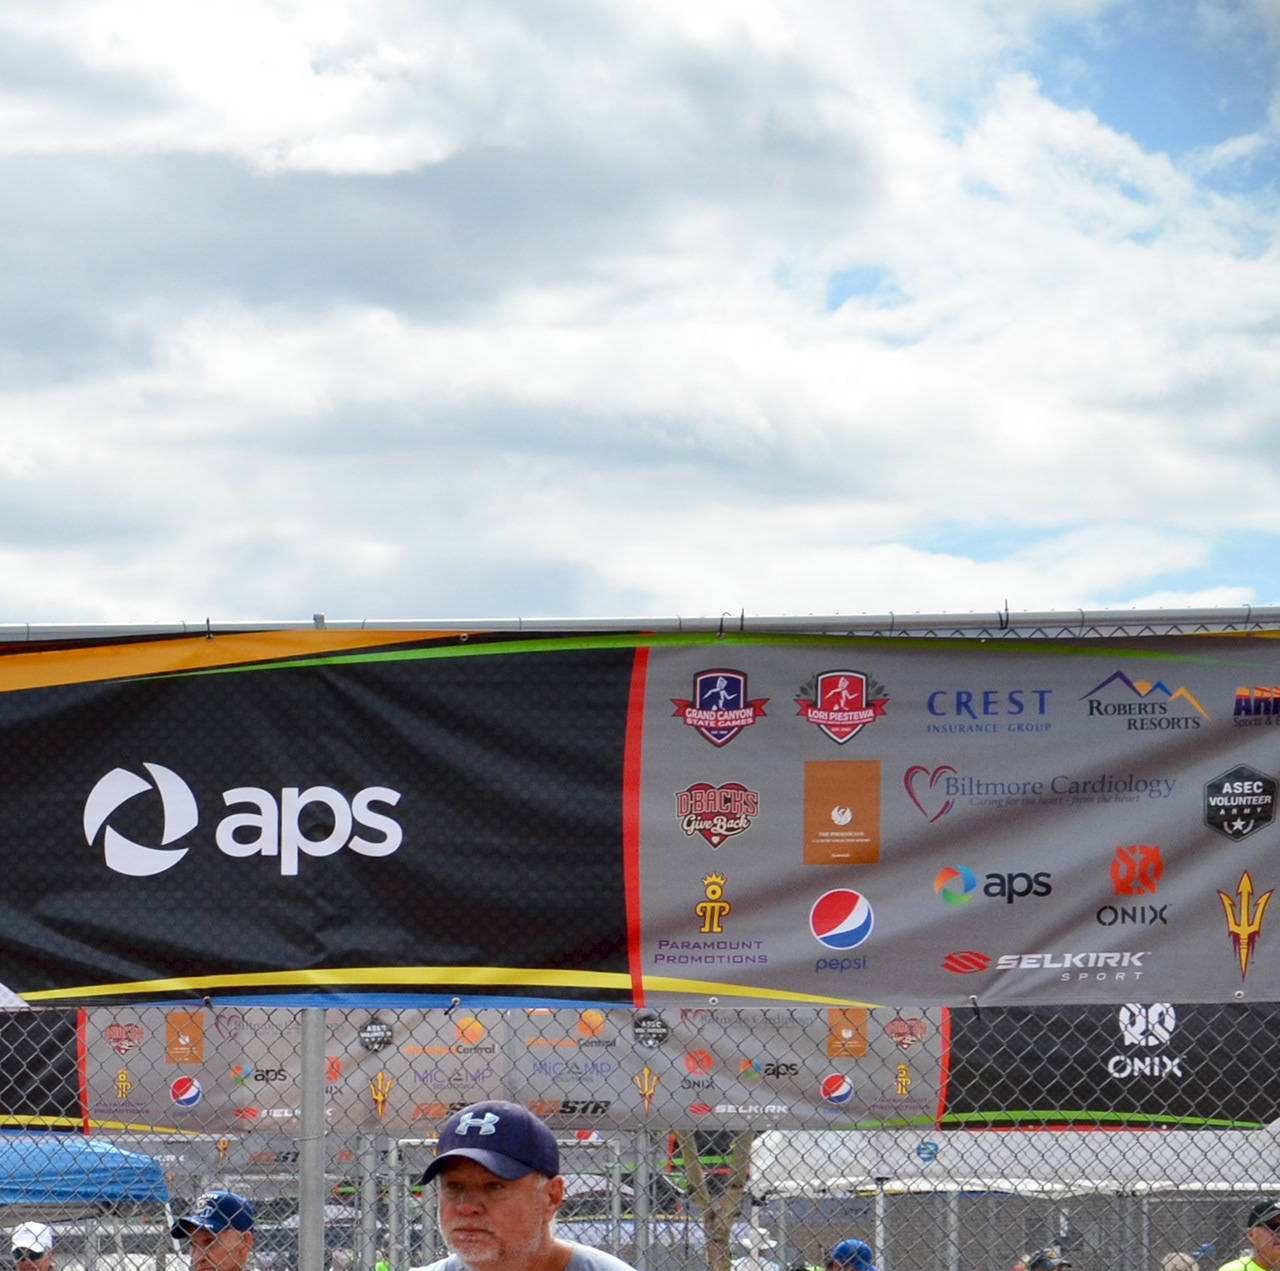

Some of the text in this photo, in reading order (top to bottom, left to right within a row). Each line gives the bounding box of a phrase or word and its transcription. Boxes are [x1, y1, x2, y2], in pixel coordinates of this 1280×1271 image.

[927, 690, 1053, 720] CREST
[685, 708, 753, 720] GRAND CANYON
[807, 709, 829, 720] LORI
[829, 709, 875, 721] PIESTEWA
[686, 718, 753, 727] STATE GAMES
[927, 723, 1052, 733] INSURANCE GROUP
[1127, 717, 1201, 731] RESORTS
[1233, 717, 1261, 728] Sports
[945, 775, 1178, 798] Biltmore Cardiology
[1222, 781, 1263, 793] ASEC
[1209, 795, 1272, 806] VOLUNTEER
[215, 786, 403, 876] aps
[682, 815, 749, 835] Give Back
[983, 871, 1052, 903] aps
[1096, 904, 1169, 927] ONIX
[658, 940, 763, 950] PARAMOUNT
[654, 954, 768, 964] PROMOTIONS
[815, 955, 867, 974] pepsi
[995, 951, 1144, 970] SELKIRK
[1061, 971, 1144, 981] SPORT
[764, 1062, 799, 1079] aps
[1107, 1055, 1182, 1079] ONIX
[253, 1067, 288, 1083] aps
[680, 1079, 715, 1091] ONIX
[715, 1104, 788, 1114] SELKIRK
